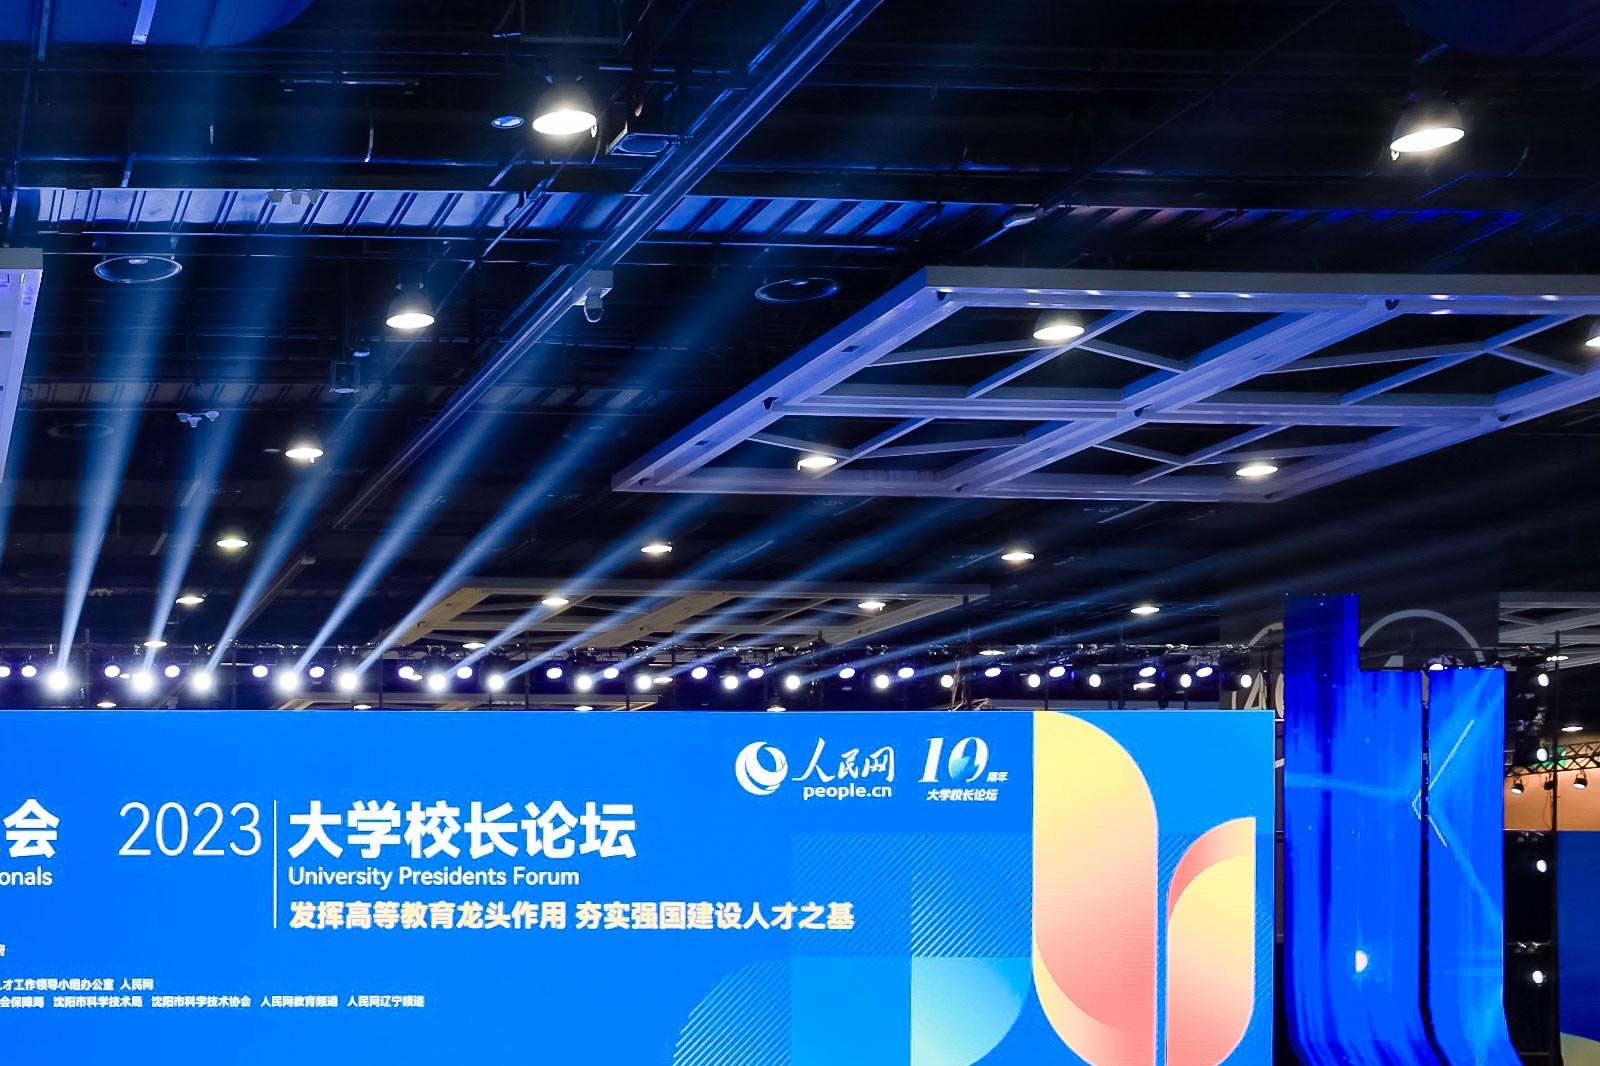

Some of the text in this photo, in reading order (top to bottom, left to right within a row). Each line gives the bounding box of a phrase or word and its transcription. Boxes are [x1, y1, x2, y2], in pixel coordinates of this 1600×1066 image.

[791, 737, 895, 783] 人民网
[918, 736, 989, 783] 10
[986, 771, 1009, 783] 周年
[803, 784, 892, 801] people.cn
[926, 788, 999, 802] 大学校长论坛
[118, 799, 637, 860] 2023 大学校长论坛
[288, 865, 580, 891] University Presidents Forum
[289, 900, 855, 931] 发挥高等教育龙头作用 夯实强国建设人才之基
[119, 978, 154, 991] 人民网
[52, 995, 143, 1008] 沈阳市科学技术局
[151, 994, 252, 1008] 沈阳市科学技术协会
[260, 995, 339, 1008] 人民网教育频道
[346, 995, 425, 1008] 人民网辽宁频道
